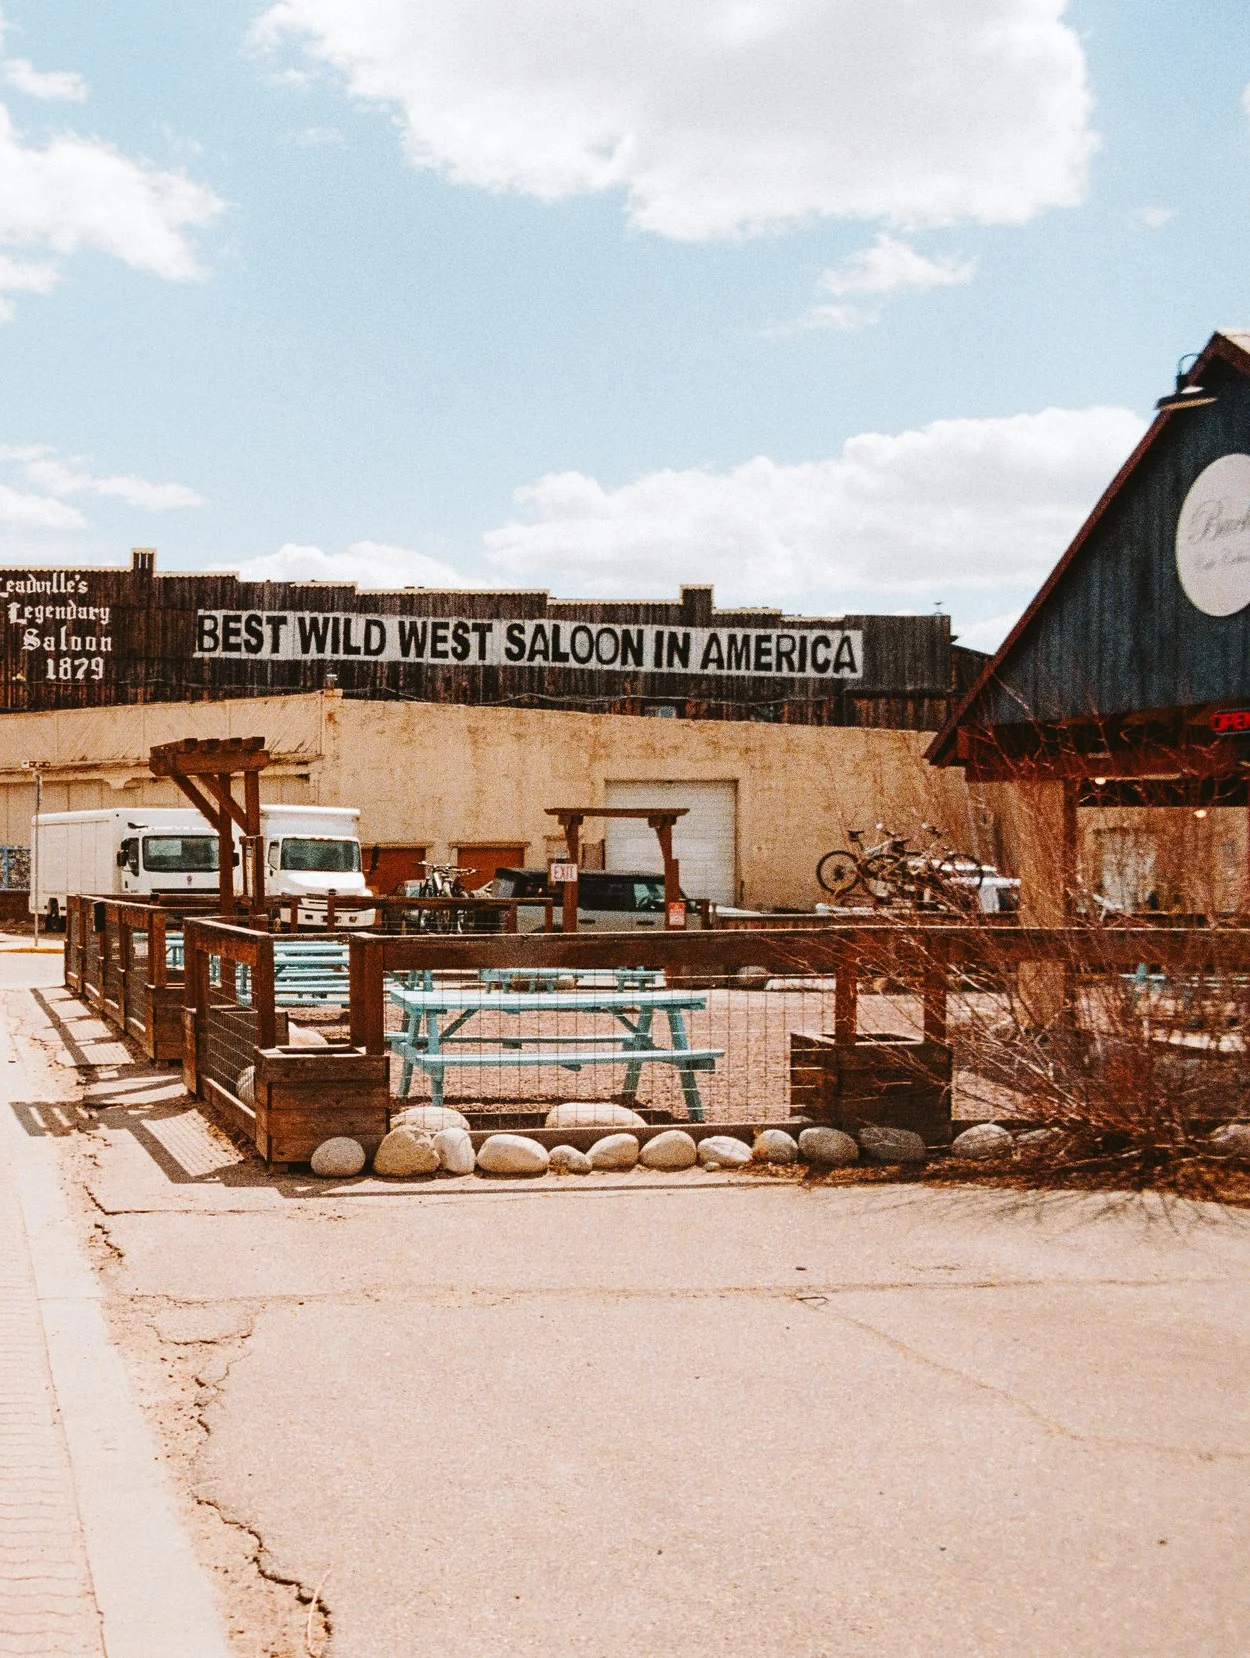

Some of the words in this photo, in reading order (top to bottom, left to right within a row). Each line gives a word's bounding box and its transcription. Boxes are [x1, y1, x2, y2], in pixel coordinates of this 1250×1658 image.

[7, 600, 110, 625] Legendary
[22, 625, 112, 651] Saloon
[197, 614, 288, 655] BEST
[297, 616, 386, 657] WILD
[399, 619, 492, 661] WEST
[504, 622, 644, 667] SALOON
[654, 630, 691, 669] IN
[700, 632, 857, 674] AMERICA
[46, 657, 104, 680] 1879
[553, 865, 575, 881] EXIT
